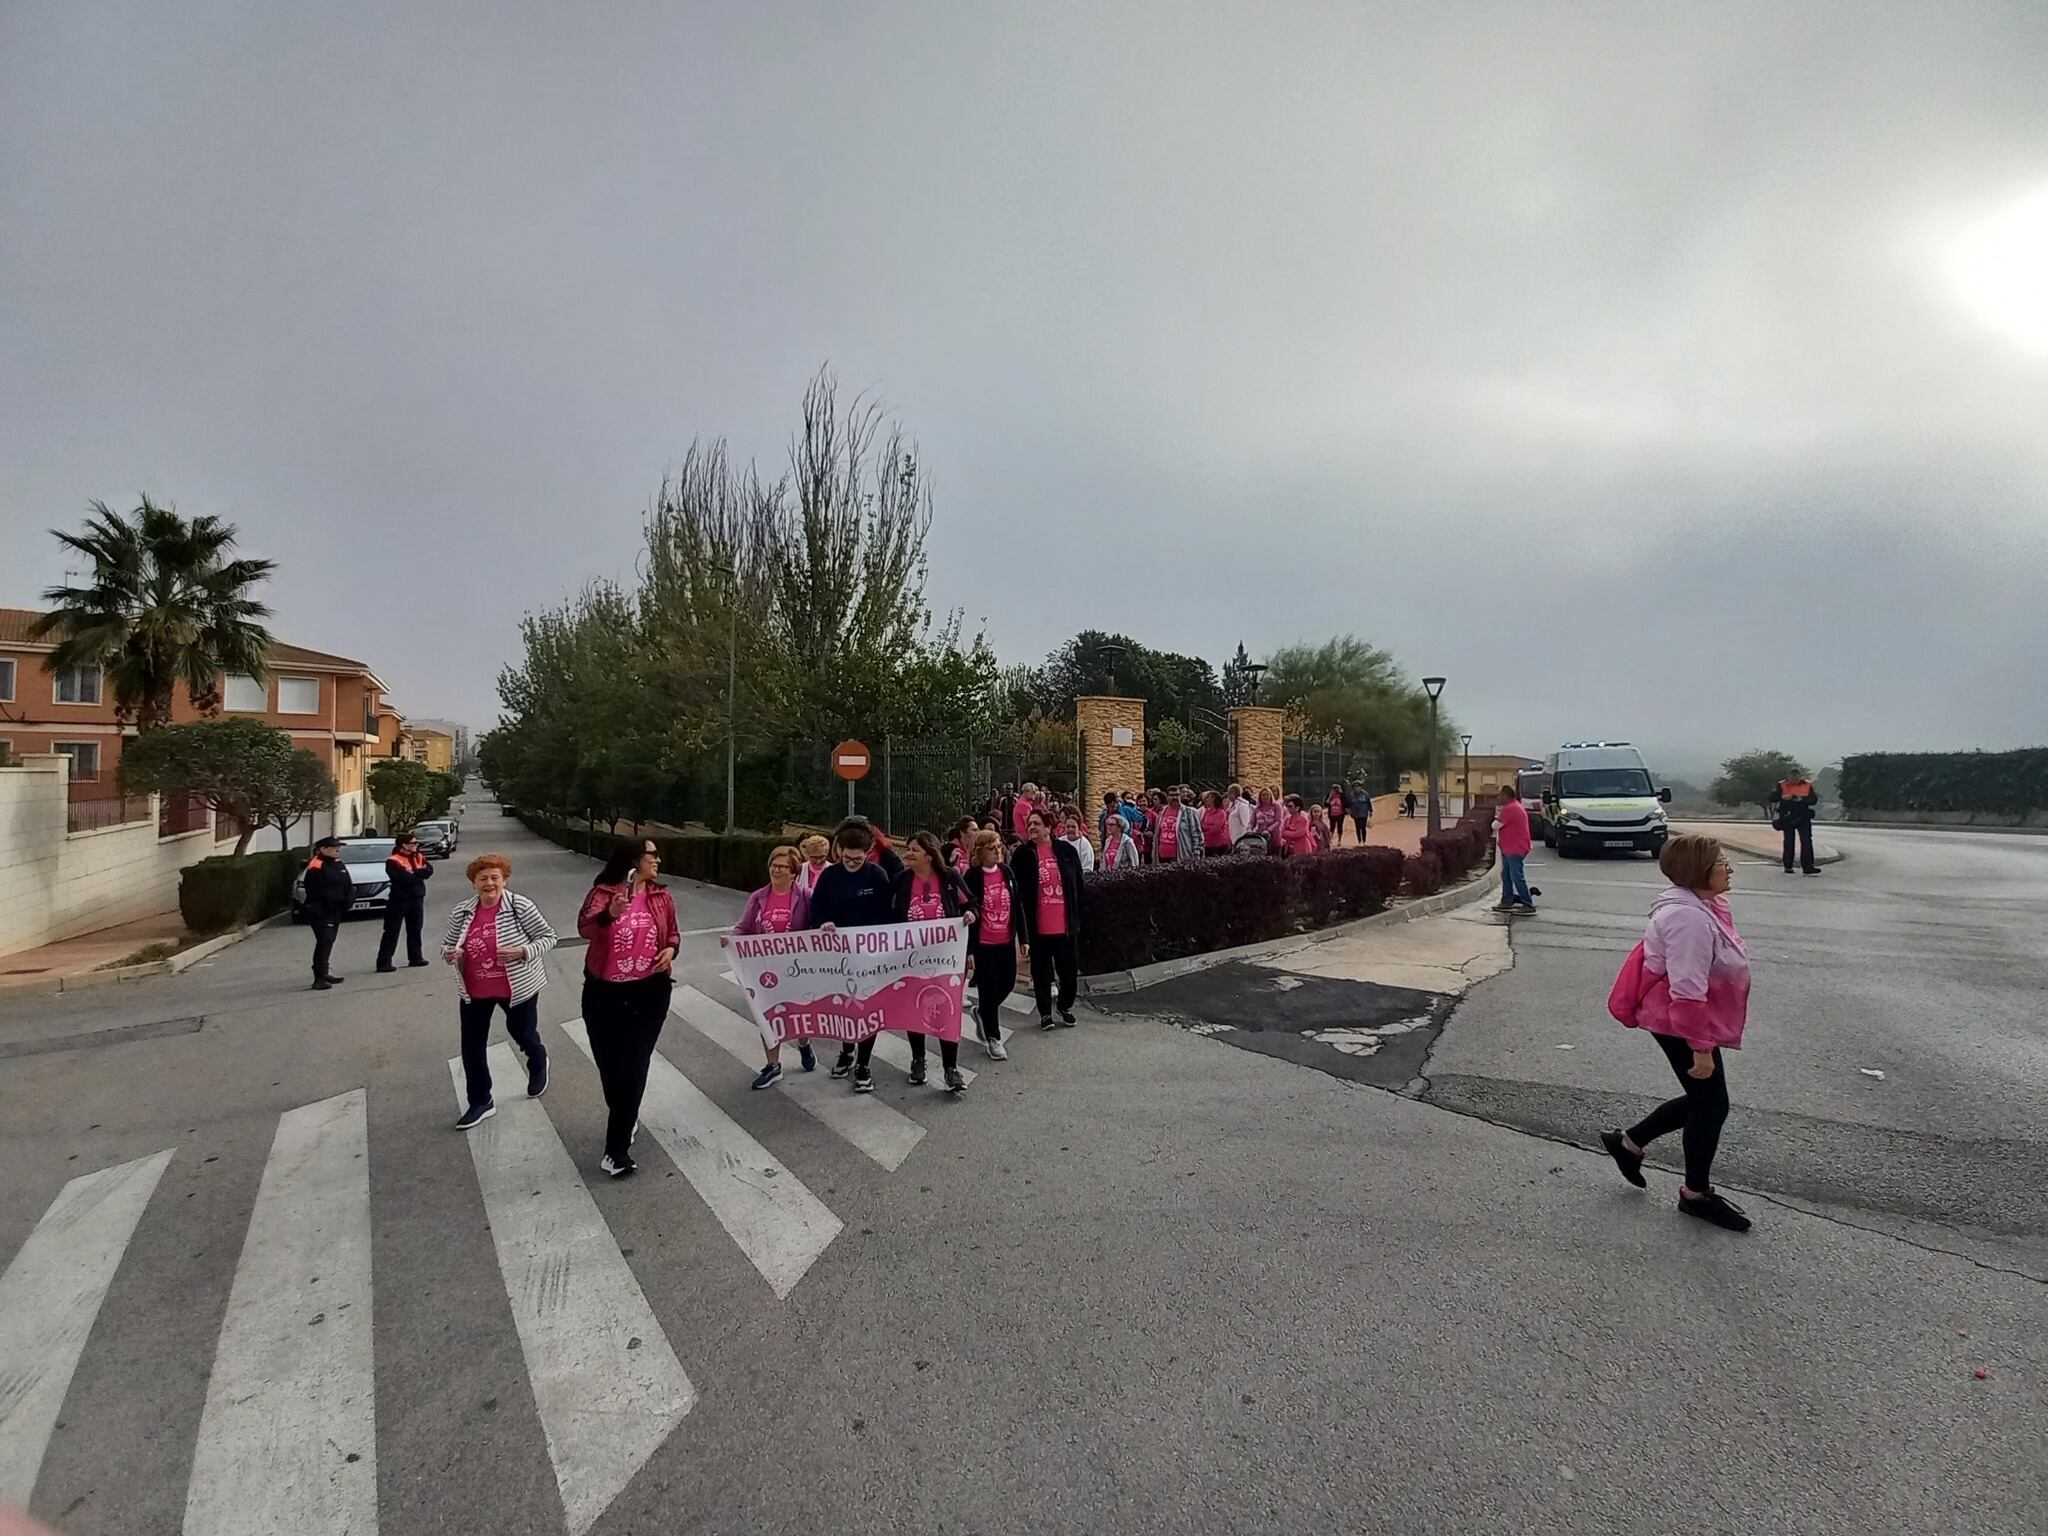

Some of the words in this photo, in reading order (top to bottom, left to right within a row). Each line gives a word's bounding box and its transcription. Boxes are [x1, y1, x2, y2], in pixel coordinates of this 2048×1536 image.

[735, 936, 808, 959] MARCHA
[811, 933, 852, 954] ROSA
[856, 931, 889, 954] POR
[894, 929, 915, 951] LA
[919, 925, 958, 947] VIDA
[819, 957, 854, 977] unido
[856, 962, 900, 978] contra
[902, 951, 920, 969] el
[789, 1013, 815, 1035] TE
[817, 1009, 886, 1040] RINDAS!
